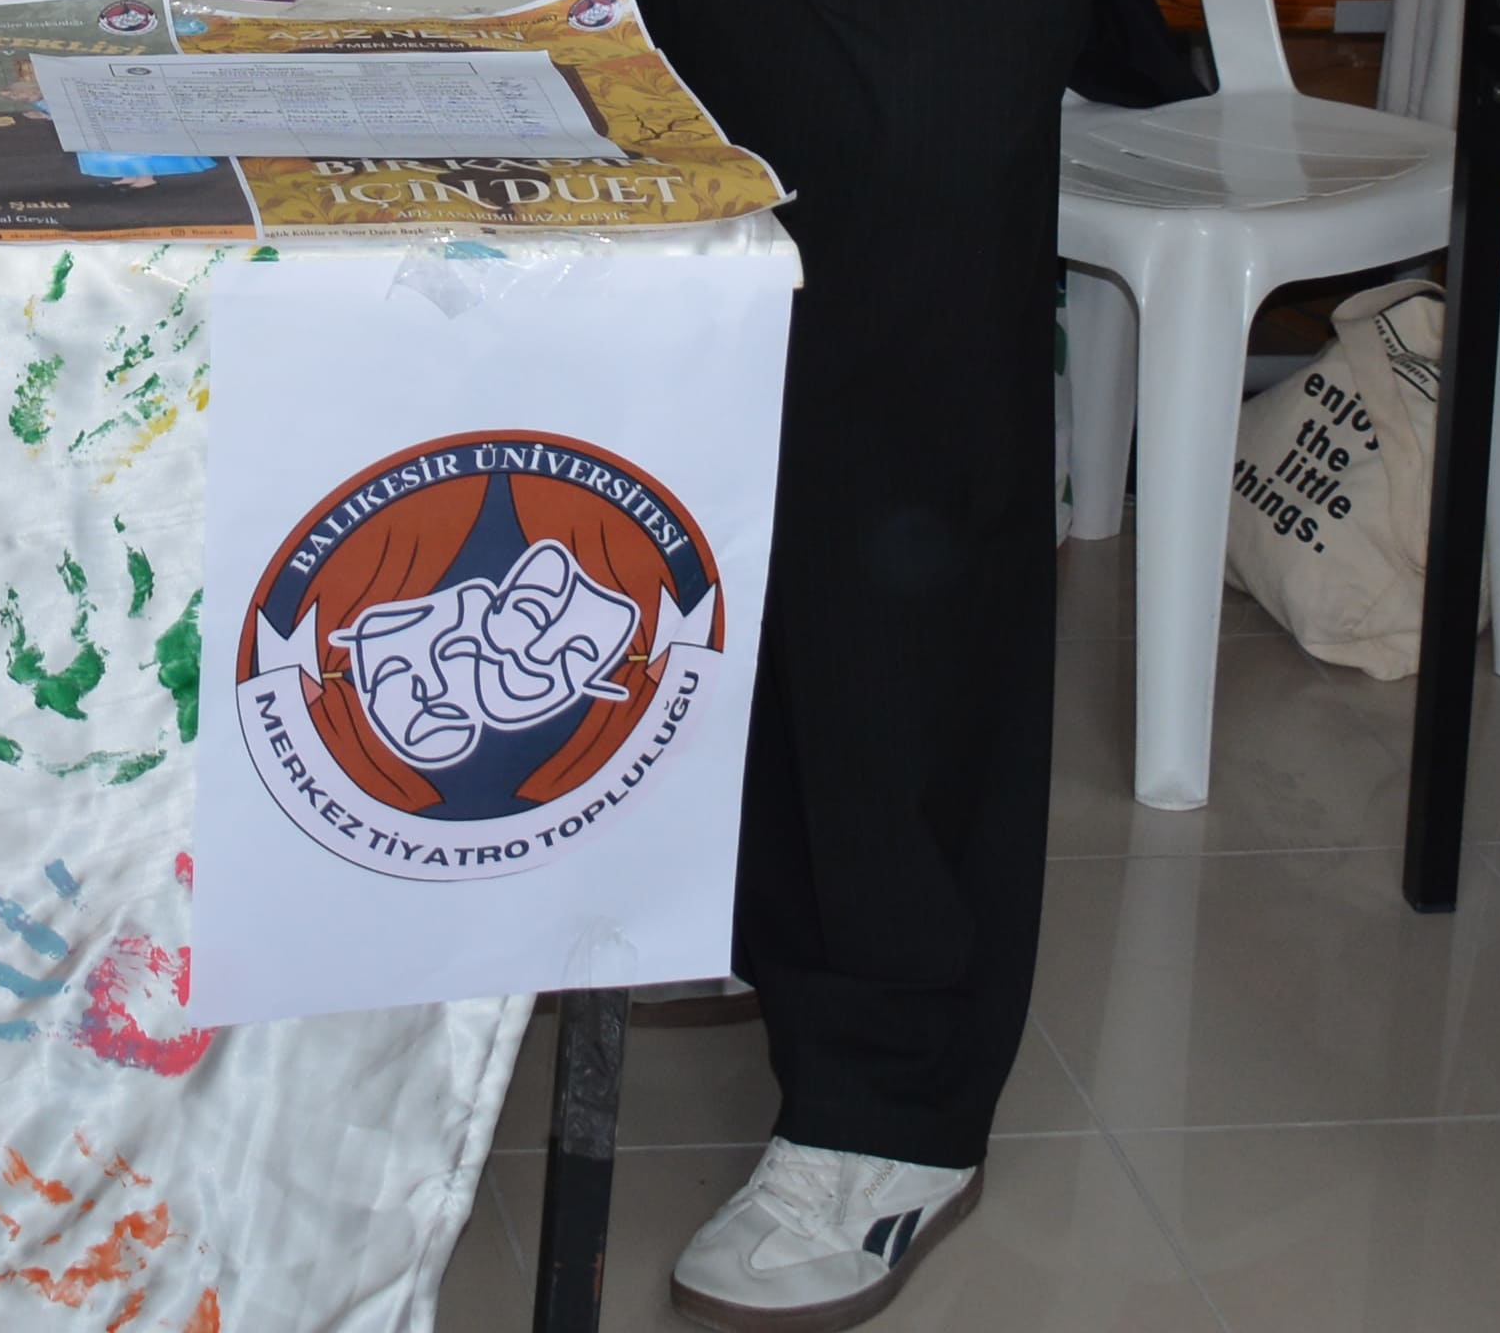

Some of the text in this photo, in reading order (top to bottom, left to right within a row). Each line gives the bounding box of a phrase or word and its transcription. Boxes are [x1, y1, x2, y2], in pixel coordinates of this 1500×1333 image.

[267, 27, 373, 41] AZİZ
[8, 200, 72, 212] Şaka
[319, 174, 686, 211] İÇİN DÜET
[521, 211, 582, 222] HAZAL
[586, 211, 634, 221] GEYİK
[1303, 372, 1381, 451] enjo
[1295, 418, 1350, 472] the
[290, 443, 690, 576] BALIKESİR ÜNİVERSİTESİ
[1233, 457, 1325, 554] things.
[1275, 449, 1353, 520] little
[255, 668, 700, 867] MERKEZ TİYATRO TOPLULUĞU
